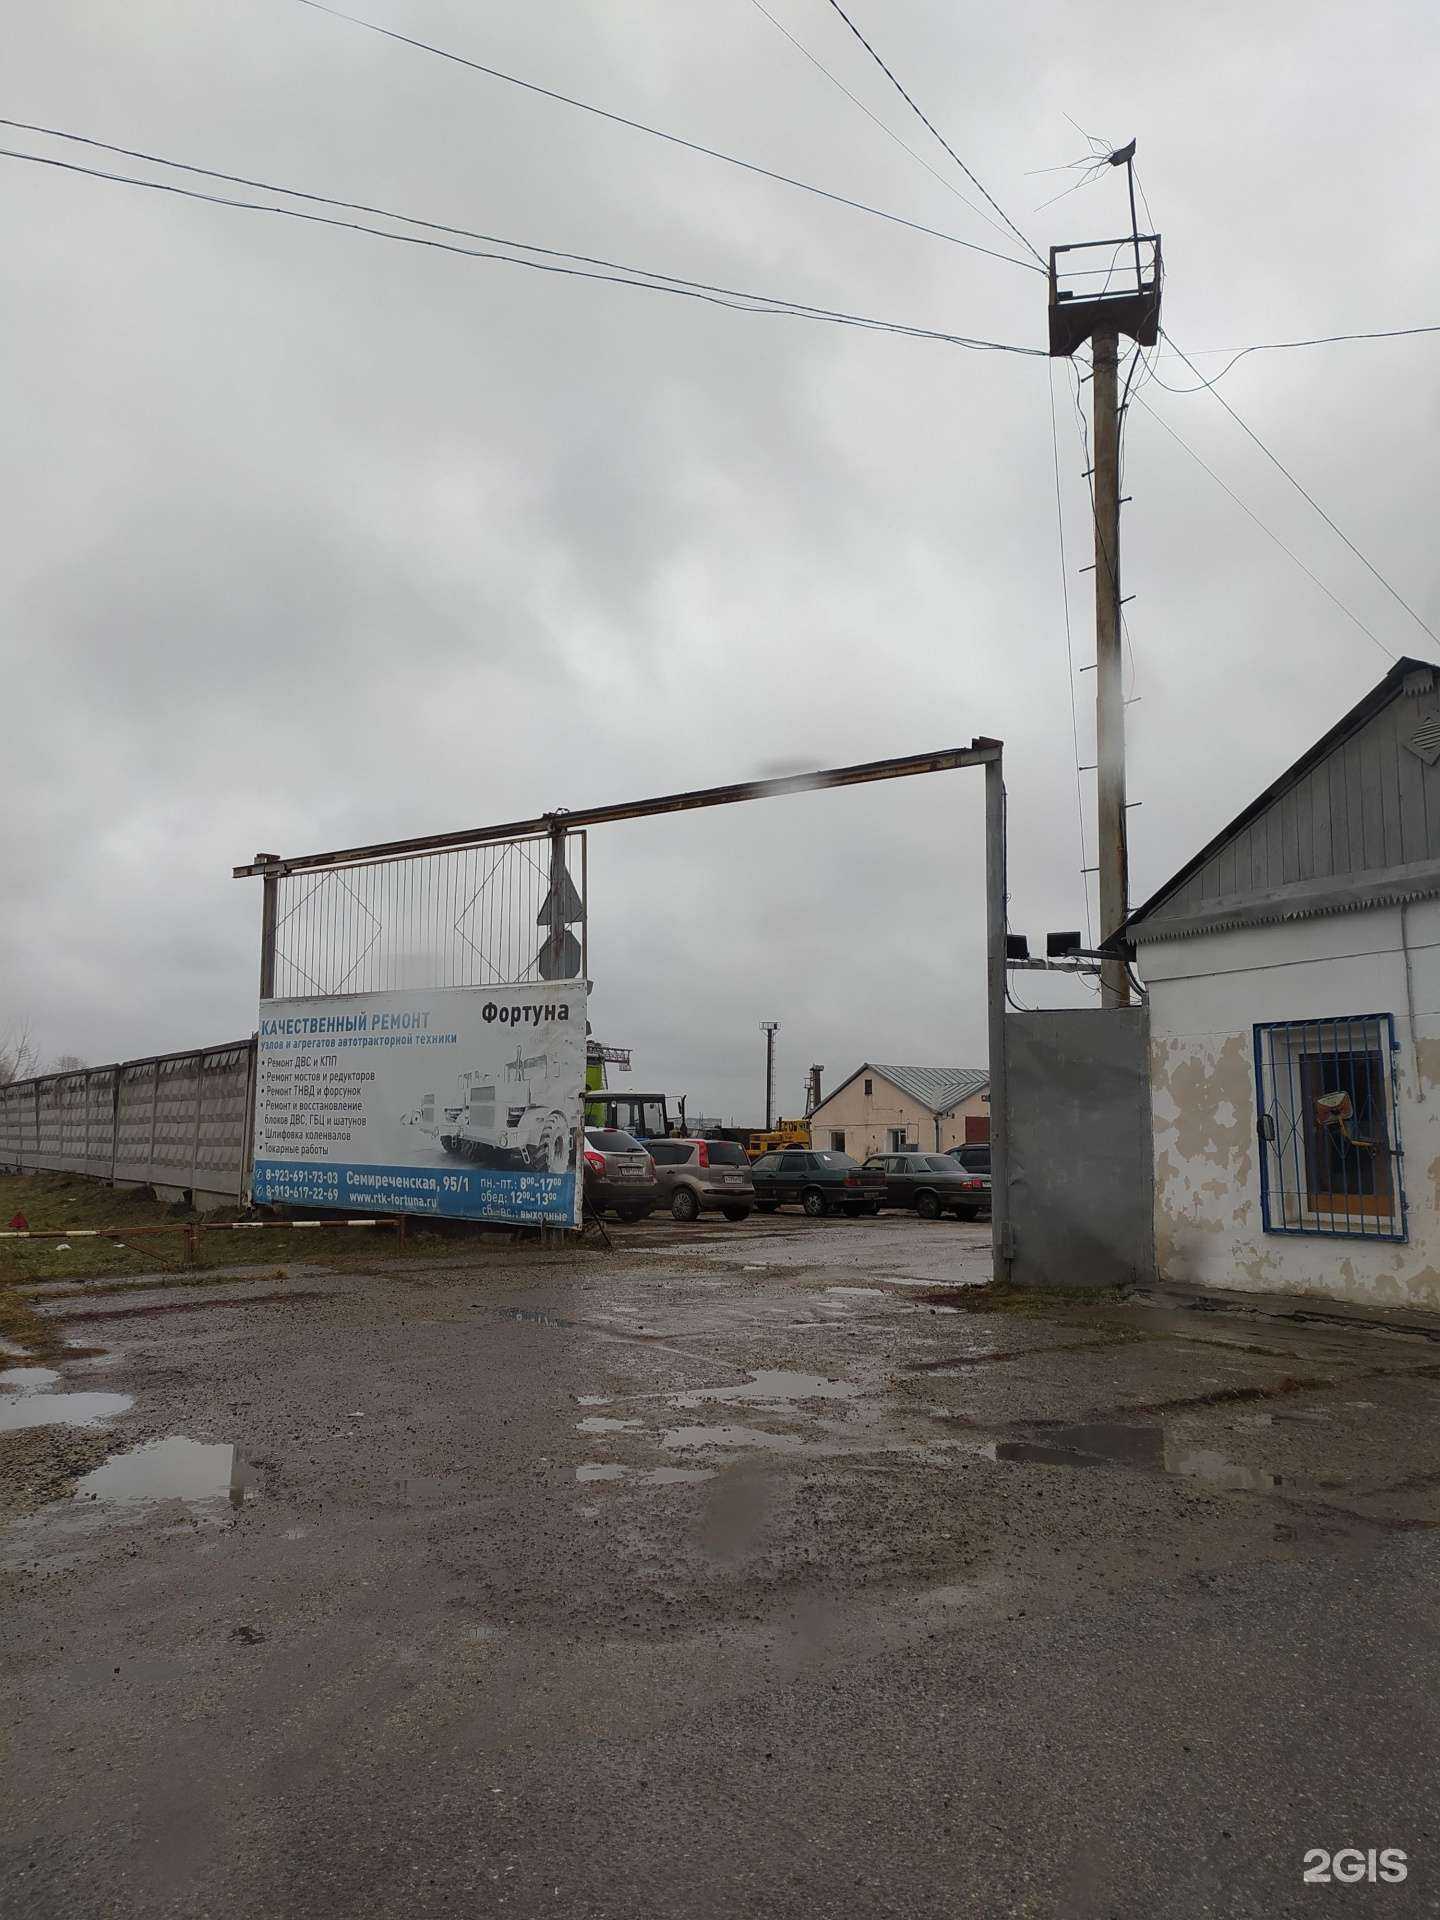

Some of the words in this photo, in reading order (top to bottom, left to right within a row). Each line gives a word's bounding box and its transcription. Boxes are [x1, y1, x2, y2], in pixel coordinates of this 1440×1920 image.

[482, 1002, 569, 1027] Фортуна
[261, 1011, 368, 1036] КАЧЕСТВЕННЫЙ
[371, 1011, 431, 1031] РЕМОНТ
[261, 1040, 284, 1051] узлов
[285, 1041, 291, 1049] и
[292, 1037, 336, 1052] агрегатов
[338, 1033, 413, 1049] автотракторной
[415, 1032, 457, 1045] техники
[267, 1057, 293, 1068] Ремонт
[295, 1056, 312, 1069] ДВС
[313, 1058, 319, 1067] и
[320, 1056, 337, 1067] КПП
[266, 1072, 292, 1082] Ремонт
[294, 1073, 321, 1082] мостов
[322, 1073, 328, 1081] и
[329, 1072, 375, 1084] редукторов
[266, 1086, 292, 1096] Ремонт
[293, 1085, 315, 1097] ТНВД
[316, 1087, 322, 1096] и
[323, 1086, 361, 1098] форсунок
[265, 1101, 291, 1111] Ремонт
[299, 1102, 362, 1111] восстановление
[264, 1114, 289, 1124] блоков
[289, 1114, 308, 1126] ДВС,
[309, 1114, 325, 1126] ГБЦ
[327, 1117, 332, 1125] и
[333, 1117, 367, 1128] шатунов
[264, 1128, 303, 1140] Шлифовка
[305, 1131, 351, 1141] коленвалов
[264, 1142, 300, 1154] Токарные
[301, 1144, 329, 1156] работы
[265, 1168, 339, 1185] 8-923-691-73-03
[346, 1170, 440, 1192] Семиреченская,
[443, 1175, 469, 1192] 95/1
[265, 1184, 339, 1201] 8-913-617-22-69
[480, 1190, 508, 1204] обед:
[349, 1192, 438, 1208] www.rtk-fortuna.ru
[520, 1210, 568, 1222] выходные
